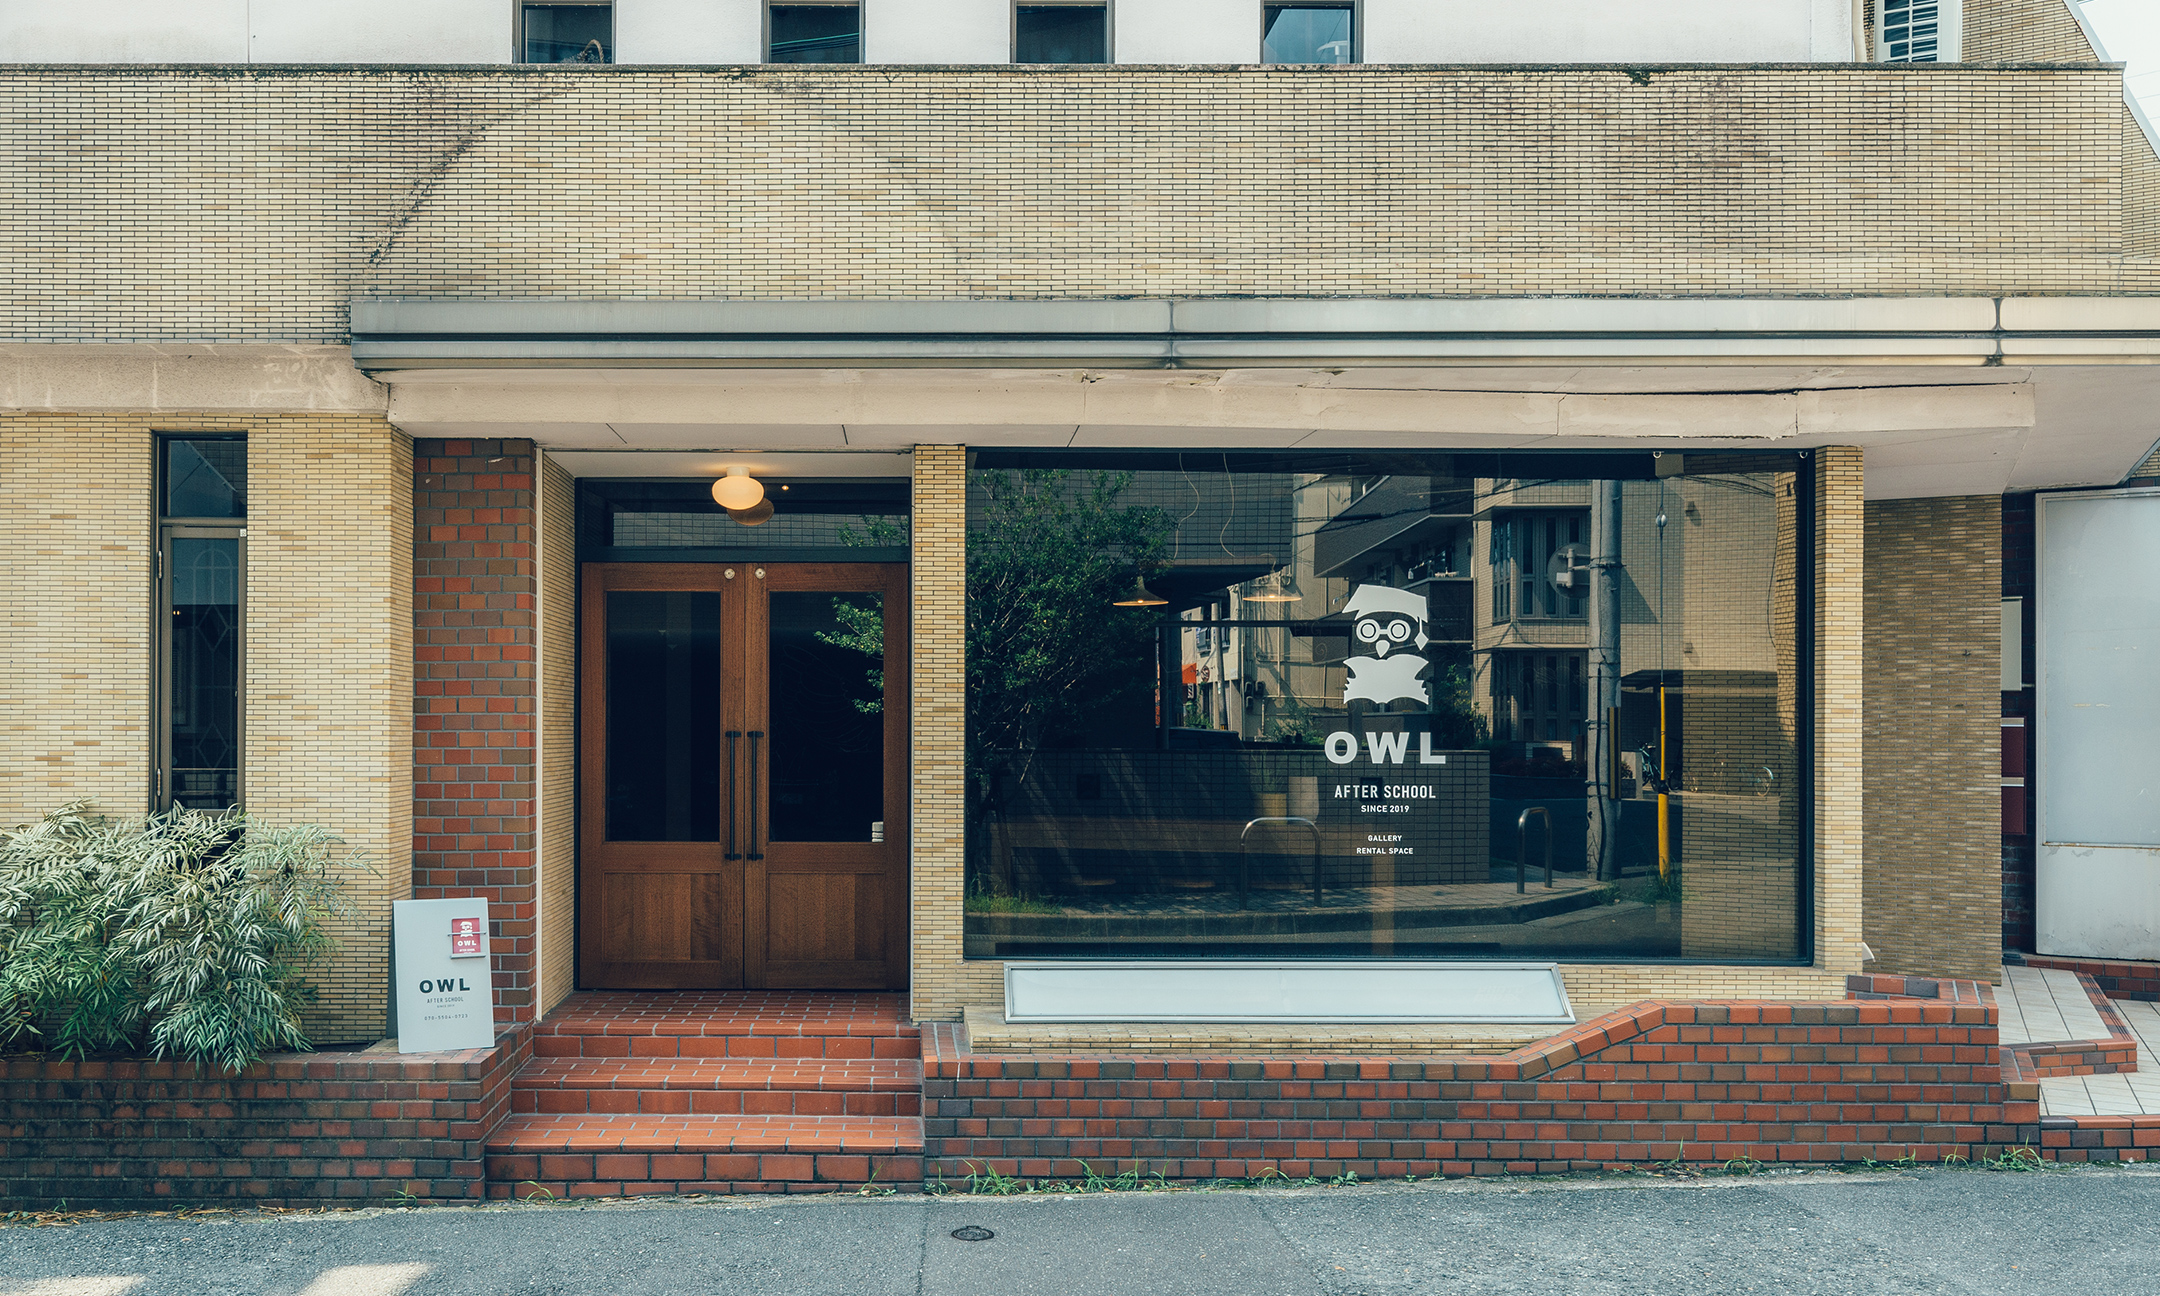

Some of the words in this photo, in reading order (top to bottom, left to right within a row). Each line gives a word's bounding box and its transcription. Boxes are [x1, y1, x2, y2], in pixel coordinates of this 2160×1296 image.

[1324, 731, 1447, 765] OWL
[1334, 785, 1379, 798] AFTER
[1383, 785, 1436, 798] SCHOOL
[1360, 804, 1388, 813] SINCE
[1389, 804, 1410, 813] 2019
[1367, 834, 1403, 842] GALLERY
[1356, 847, 1386, 855] RENTAL
[1388, 847, 1414, 855] SPACE
[419, 978, 470, 994] OWL
